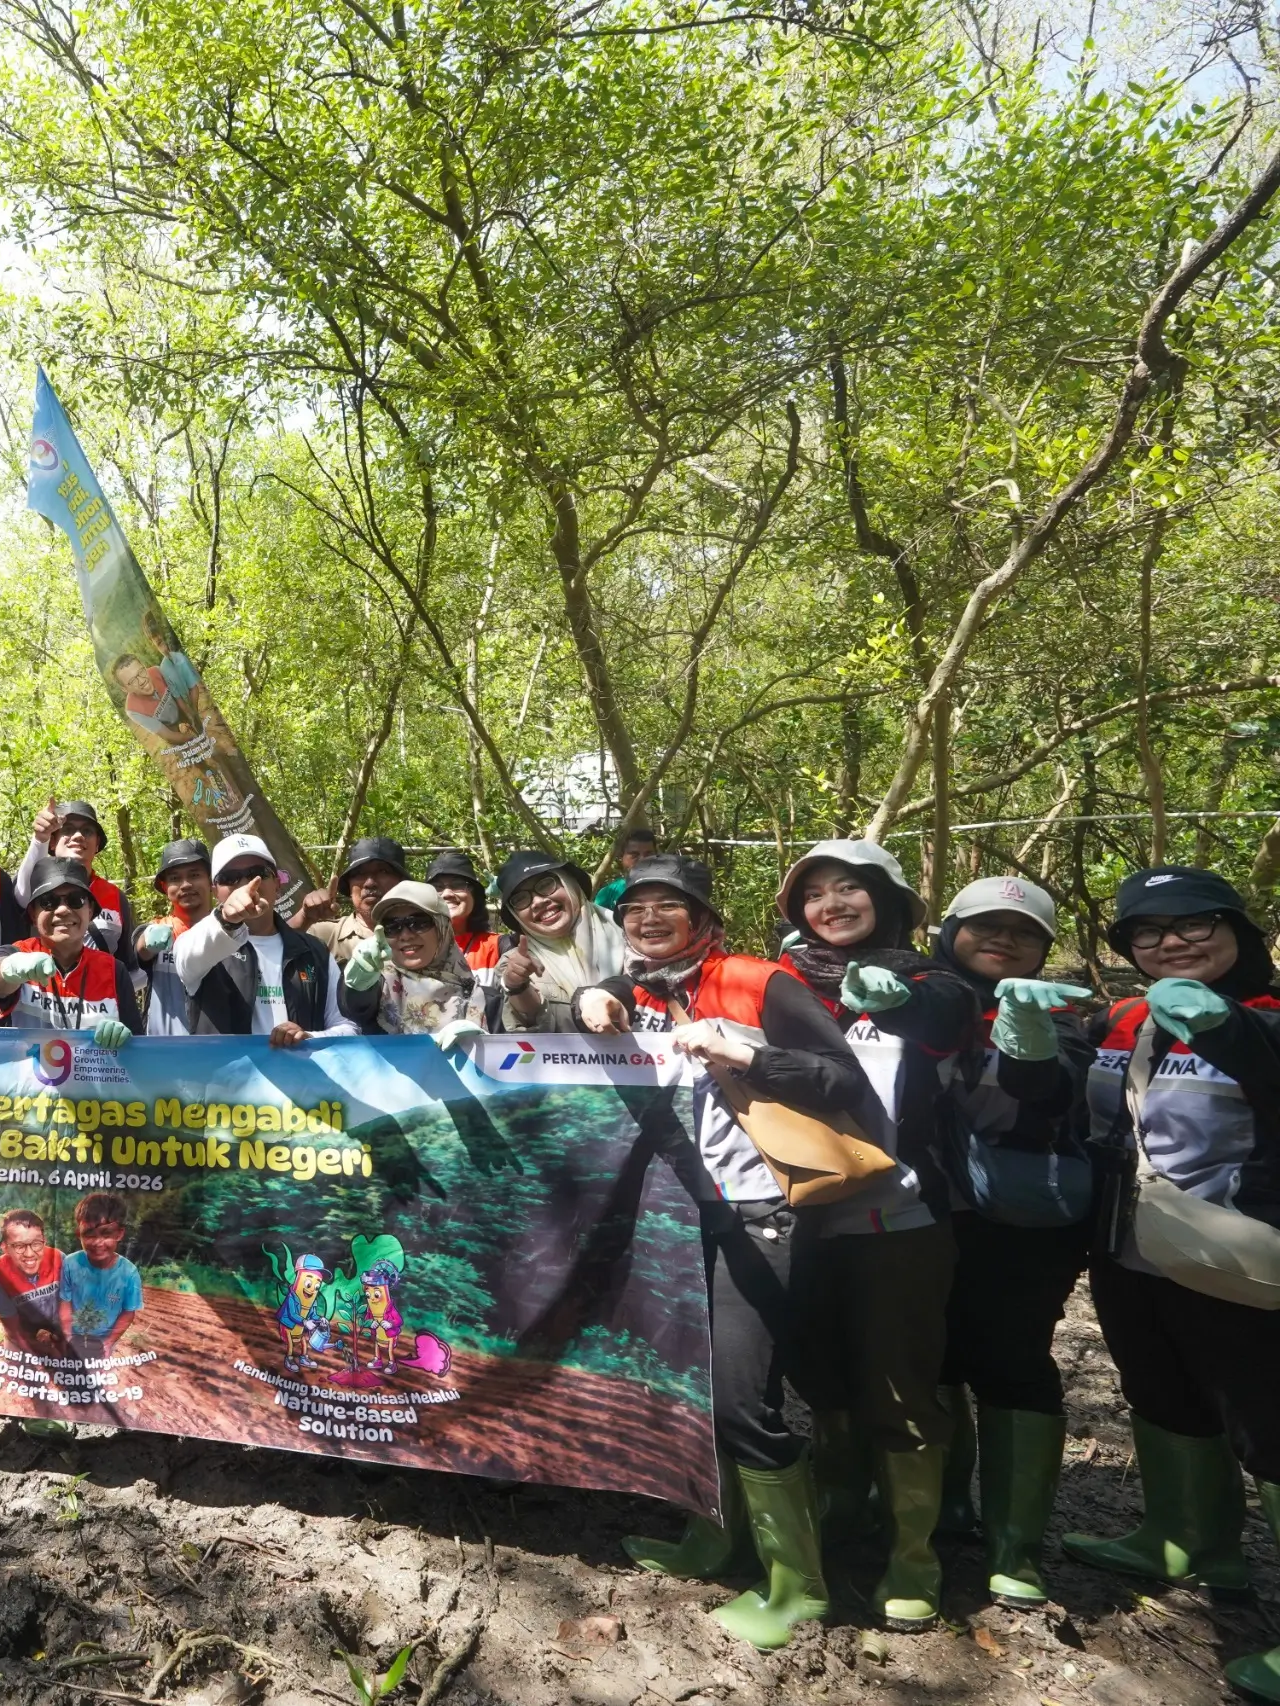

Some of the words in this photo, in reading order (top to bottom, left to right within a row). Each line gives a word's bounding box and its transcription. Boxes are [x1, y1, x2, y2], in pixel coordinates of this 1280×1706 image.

[74, 1047, 118, 1058] Energizing
[74, 1056, 108, 1065] Growth.
[542, 1053, 628, 1065] PERTAMINA
[630, 1053, 666, 1066] GAS
[74, 1065, 126, 1075] Empowering
[74, 1073, 132, 1083] Communities.
[154, 1097, 343, 1137] Mengabdi
[0, 1129, 103, 1164] Bakti
[111, 1135, 231, 1168] Untuk
[238, 1139, 373, 1181] Negeri
[48, 1169, 60, 1185] 6
[63, 1170, 112, 1190] April
[115, 1173, 164, 1190] 2026
[24, 1351, 83, 1370] Terhadap
[84, 1349, 157, 1371] Lingkungan
[53, 1370, 118, 1390] Rangka
[233, 1358, 308, 1397] Mendukung
[310, 1384, 409, 1405] Dekarbonisasi
[411, 1387, 461, 1405] Melalui
[6, 1380, 93, 1406] Pertagas
[94, 1384, 144, 1404] Ke-19
[274, 1390, 418, 1425] Nature-Based
[298, 1415, 393, 1442] Solution
